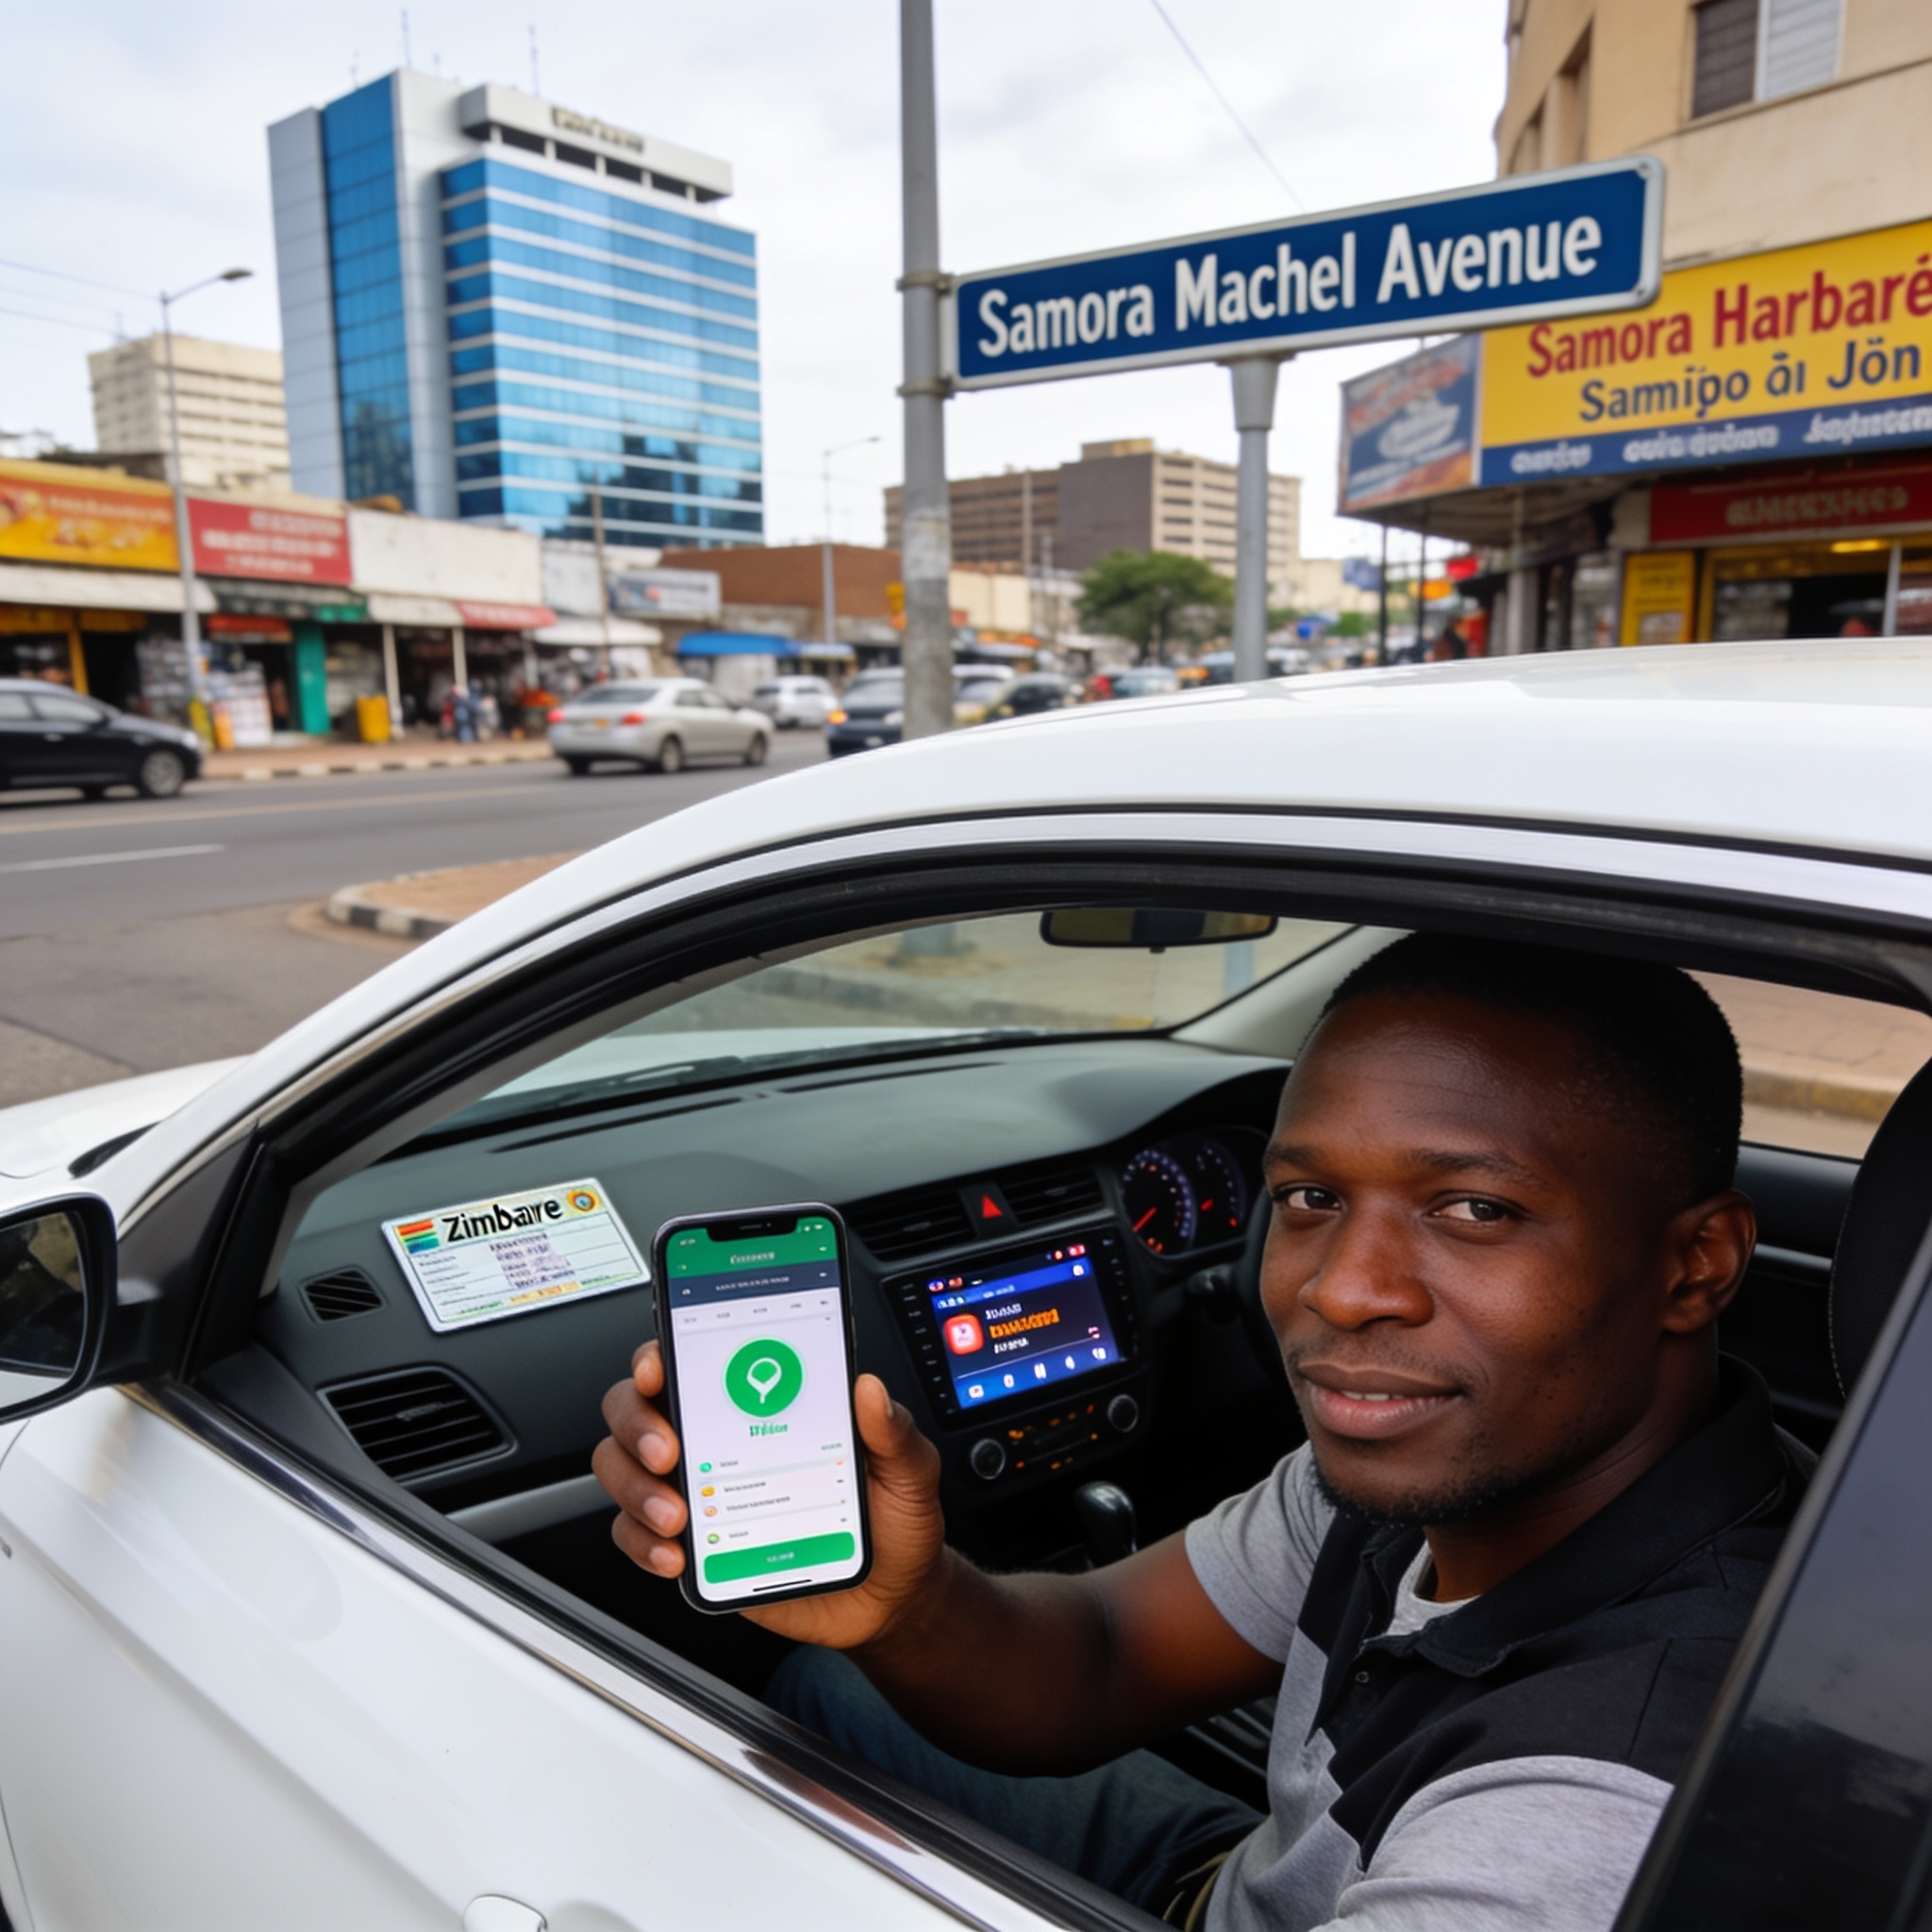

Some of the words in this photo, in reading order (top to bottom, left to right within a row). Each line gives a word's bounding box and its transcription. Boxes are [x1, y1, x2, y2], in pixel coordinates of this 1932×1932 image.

[978, 284, 1155, 358] Samora
[1175, 231, 1356, 332] Machel
[1376, 216, 1602, 303] Avenue
[1527, 312, 1691, 377] Samora
